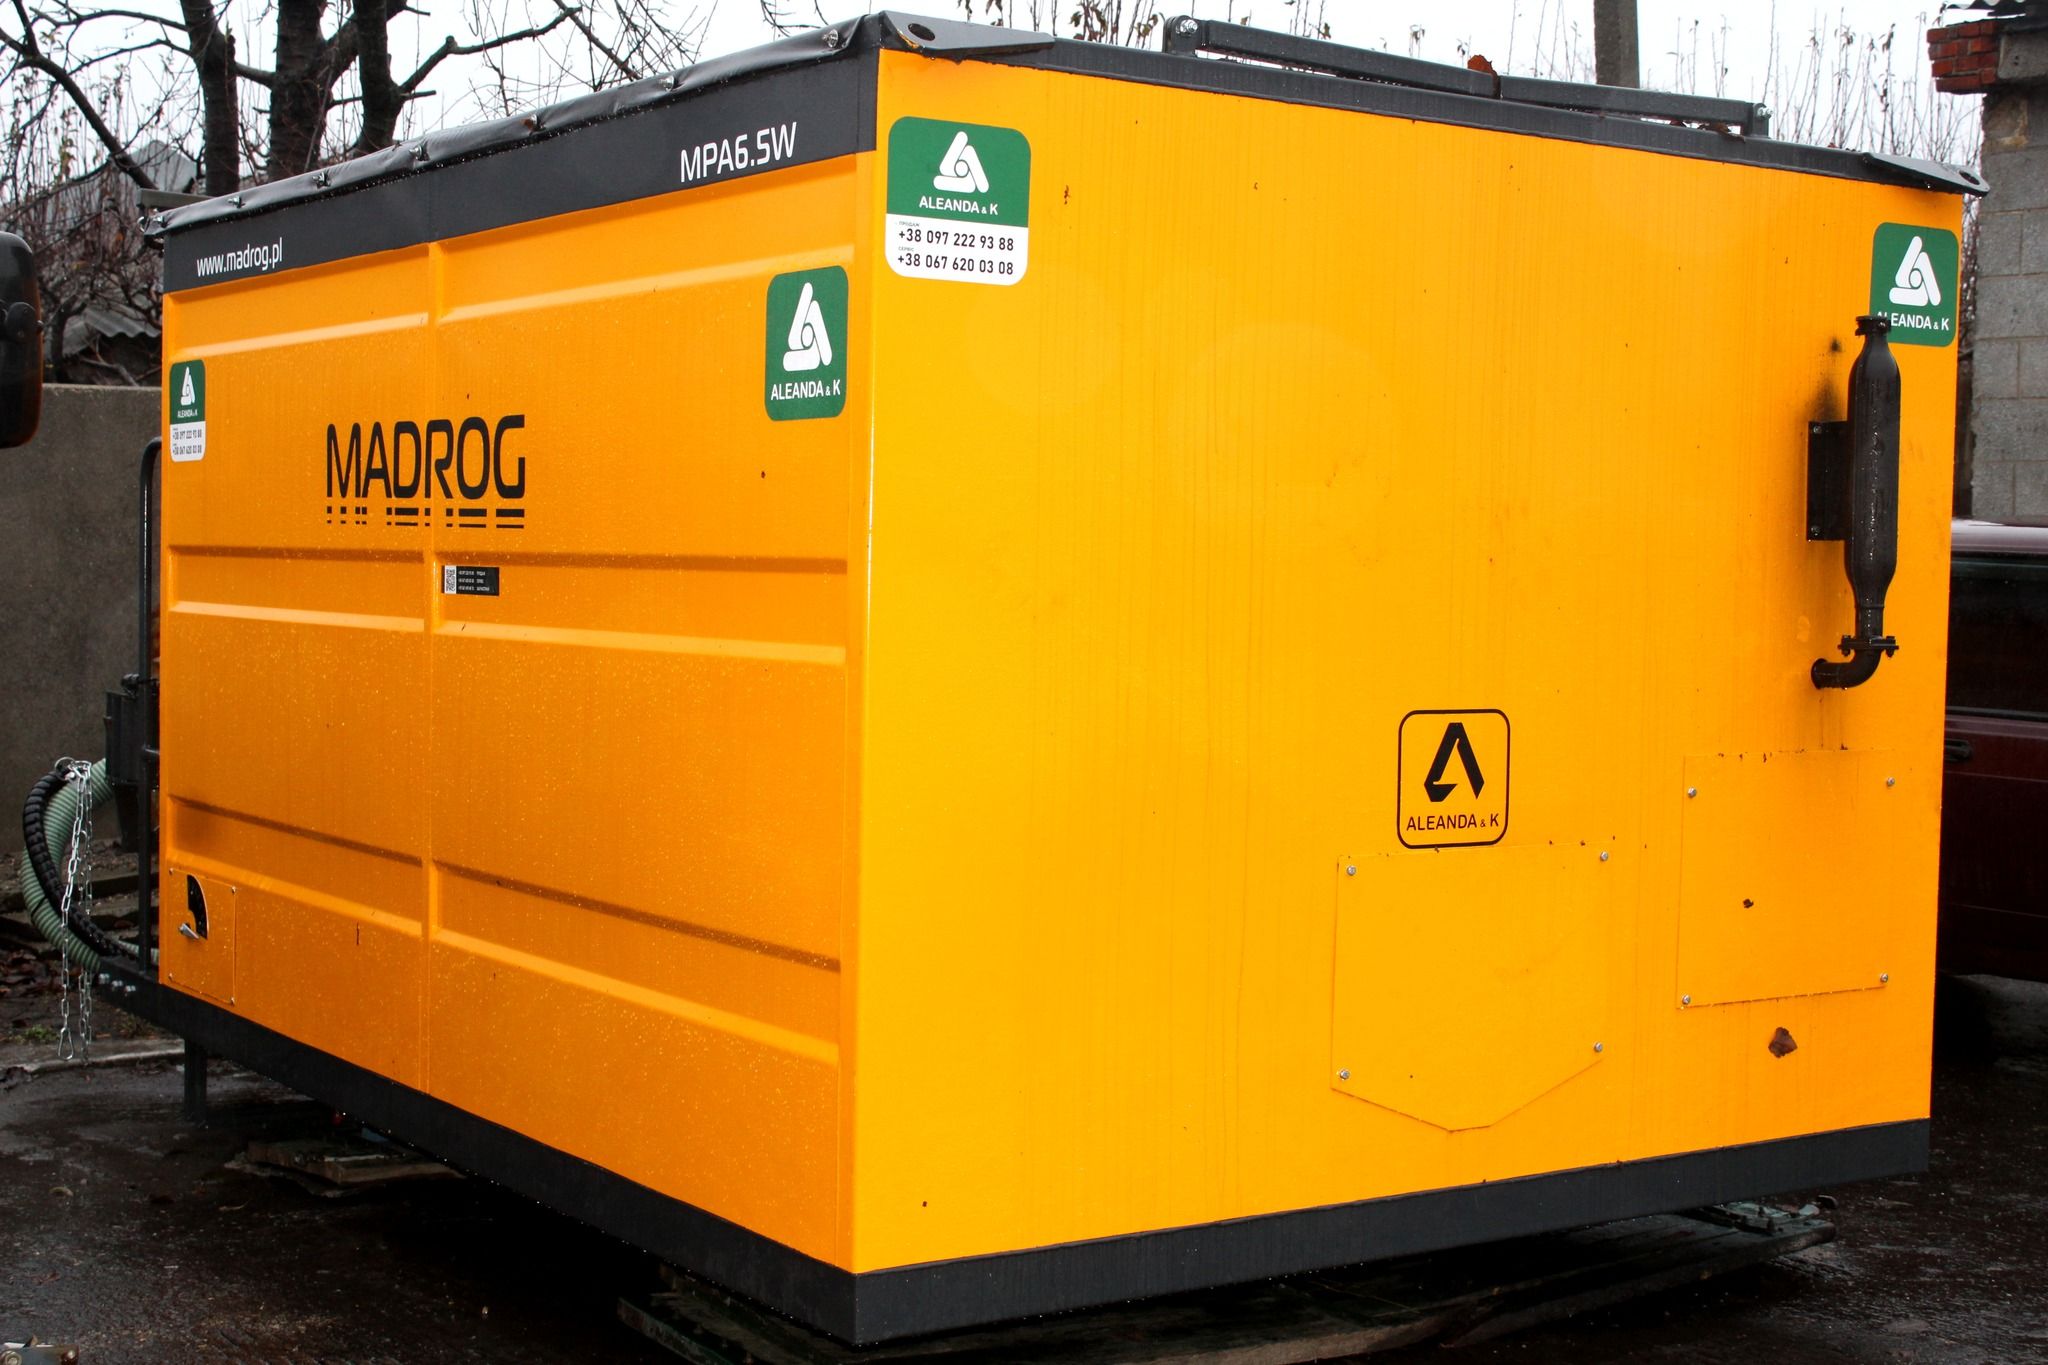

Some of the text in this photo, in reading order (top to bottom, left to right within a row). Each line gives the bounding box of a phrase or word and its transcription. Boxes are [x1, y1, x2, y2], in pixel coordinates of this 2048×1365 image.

[919, 195, 999, 216] ALEANDA & K
[899, 228, 1014, 252] +38 097 222 93 88
[196, 236, 283, 278] www.madrog.pl
[898, 252, 1014, 276] +38 067 620 03 08
[1933, 321, 1939, 330] &
[1941, 317, 1950, 331] K
[770, 379, 841, 401] ALEANDA & K
[326, 414, 526, 500] MADROG
[1406, 813, 1499, 831] ALEANDA & K
